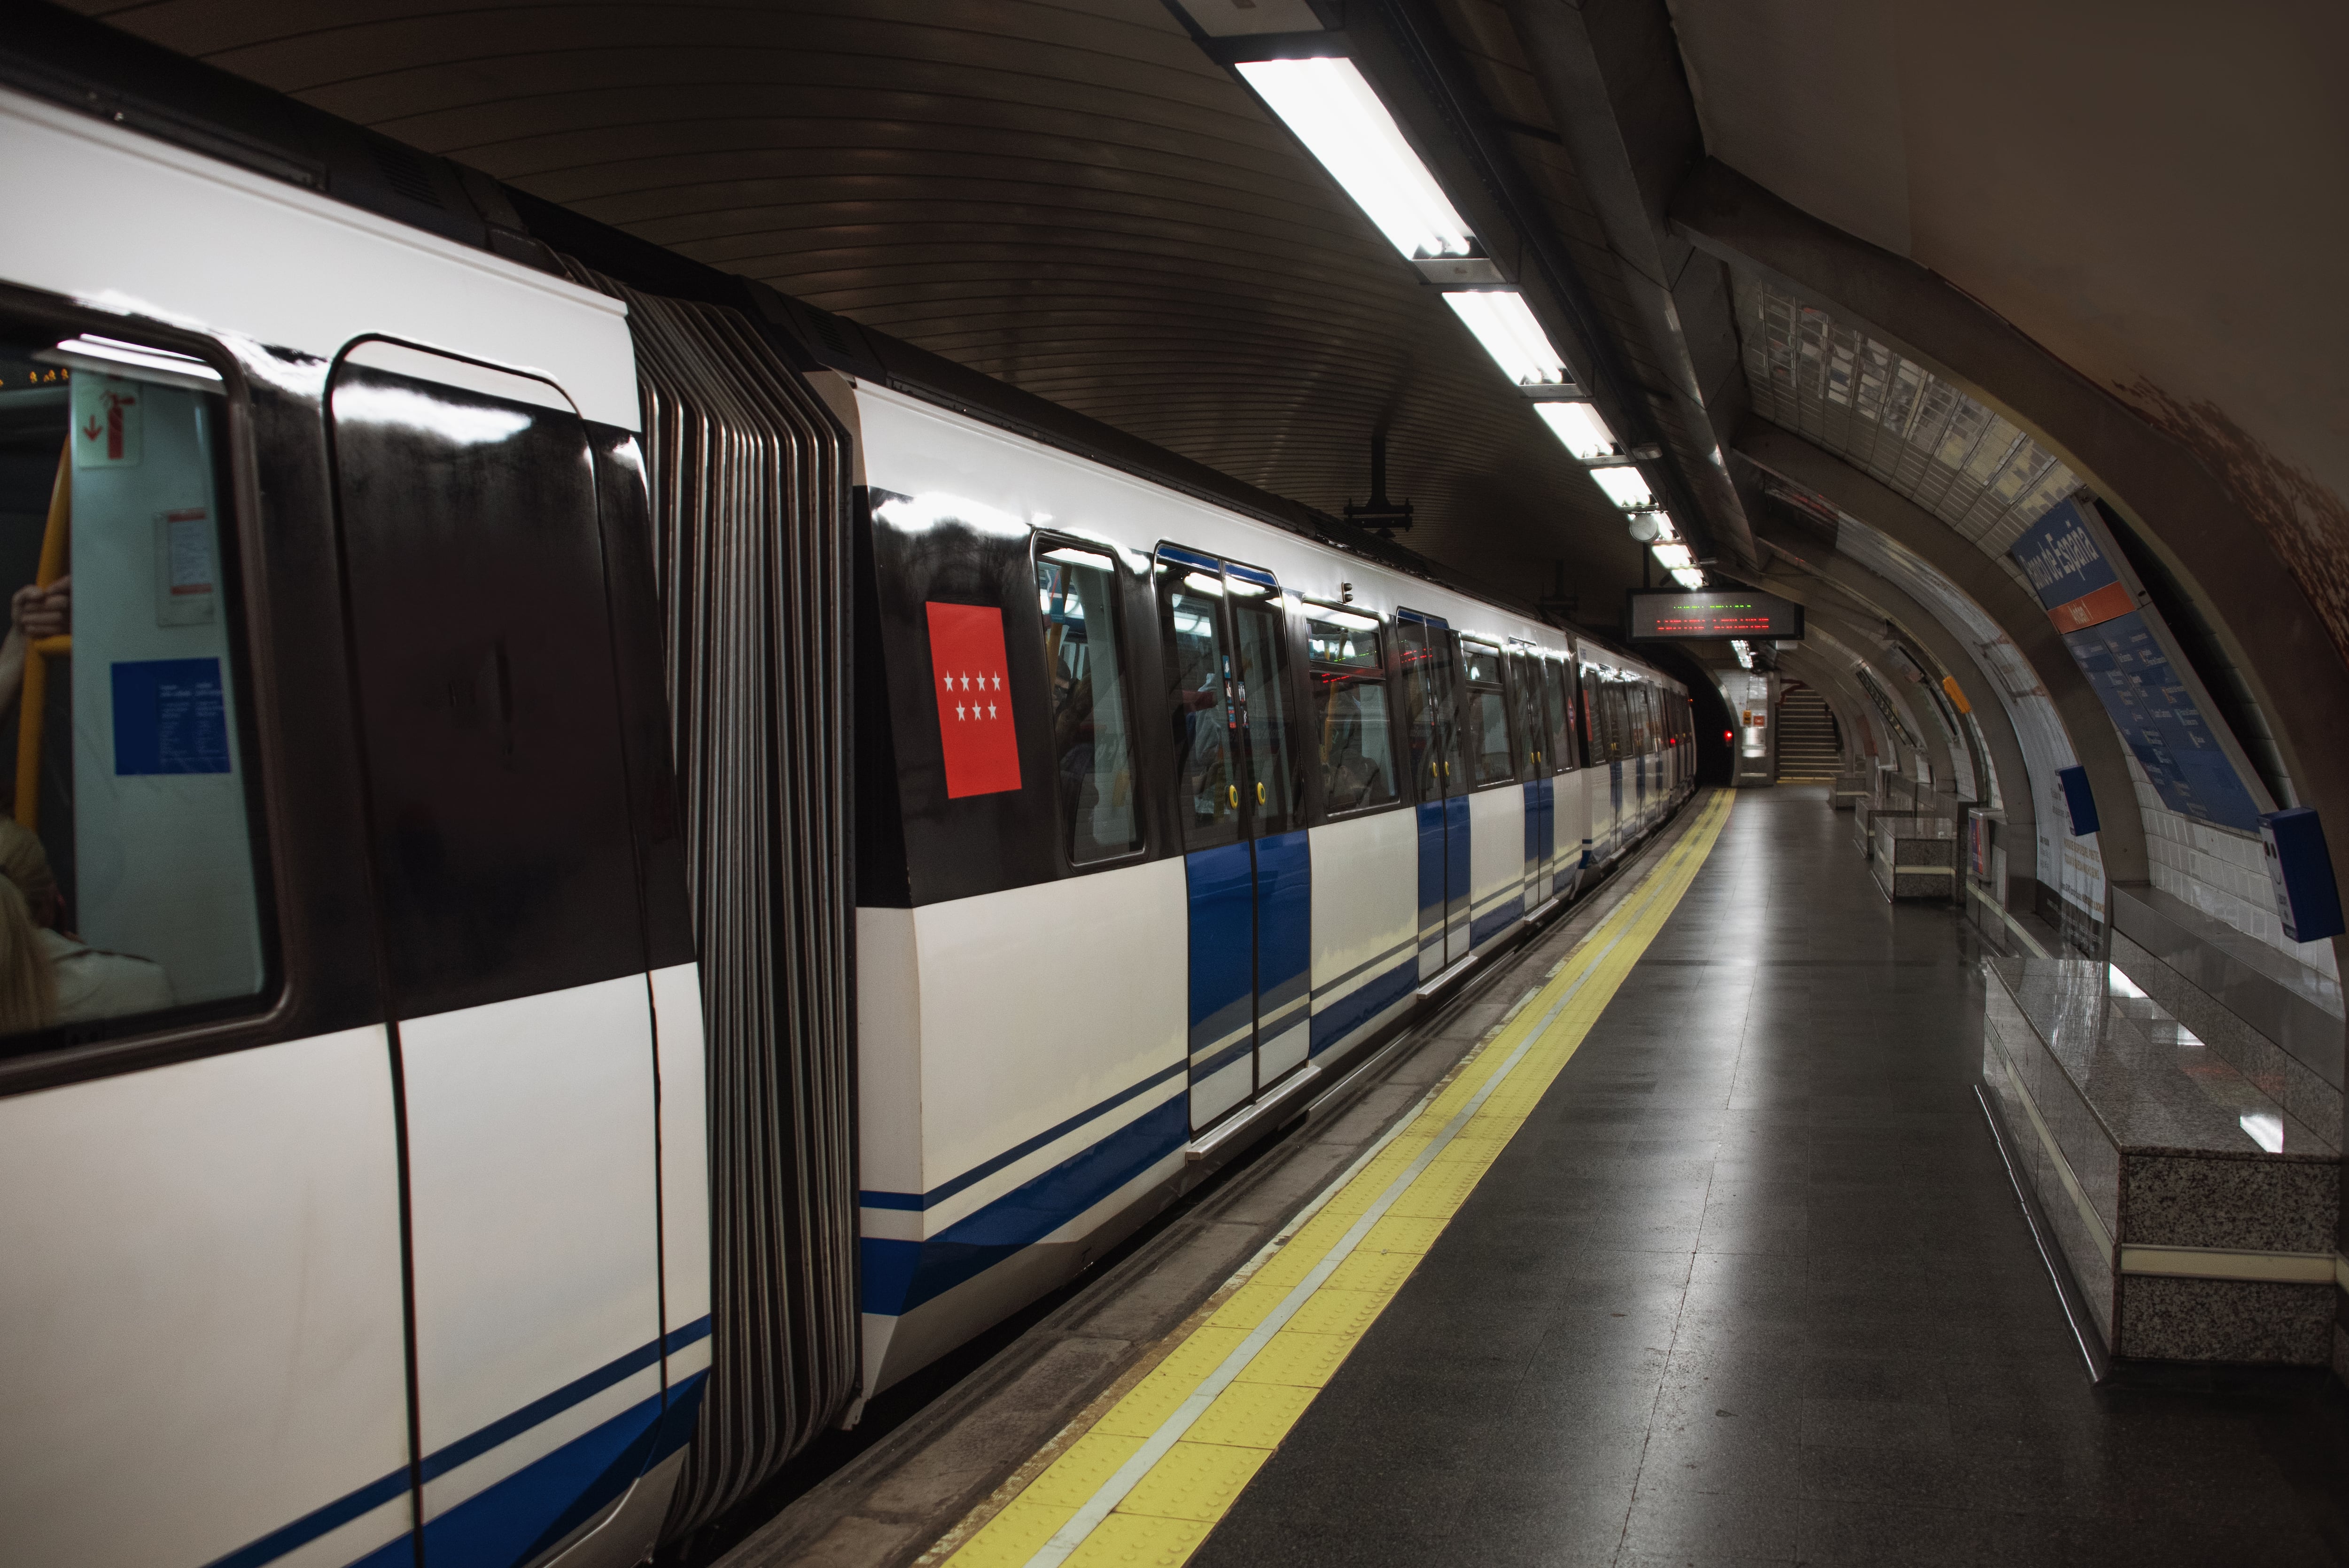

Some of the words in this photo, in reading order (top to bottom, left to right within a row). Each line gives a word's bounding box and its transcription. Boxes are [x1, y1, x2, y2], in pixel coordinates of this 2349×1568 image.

[2037, 541, 2063, 581] de
[2045, 519, 2100, 581] España
[2019, 554, 2053, 590] Banco
[2081, 599, 2094, 620] 1
